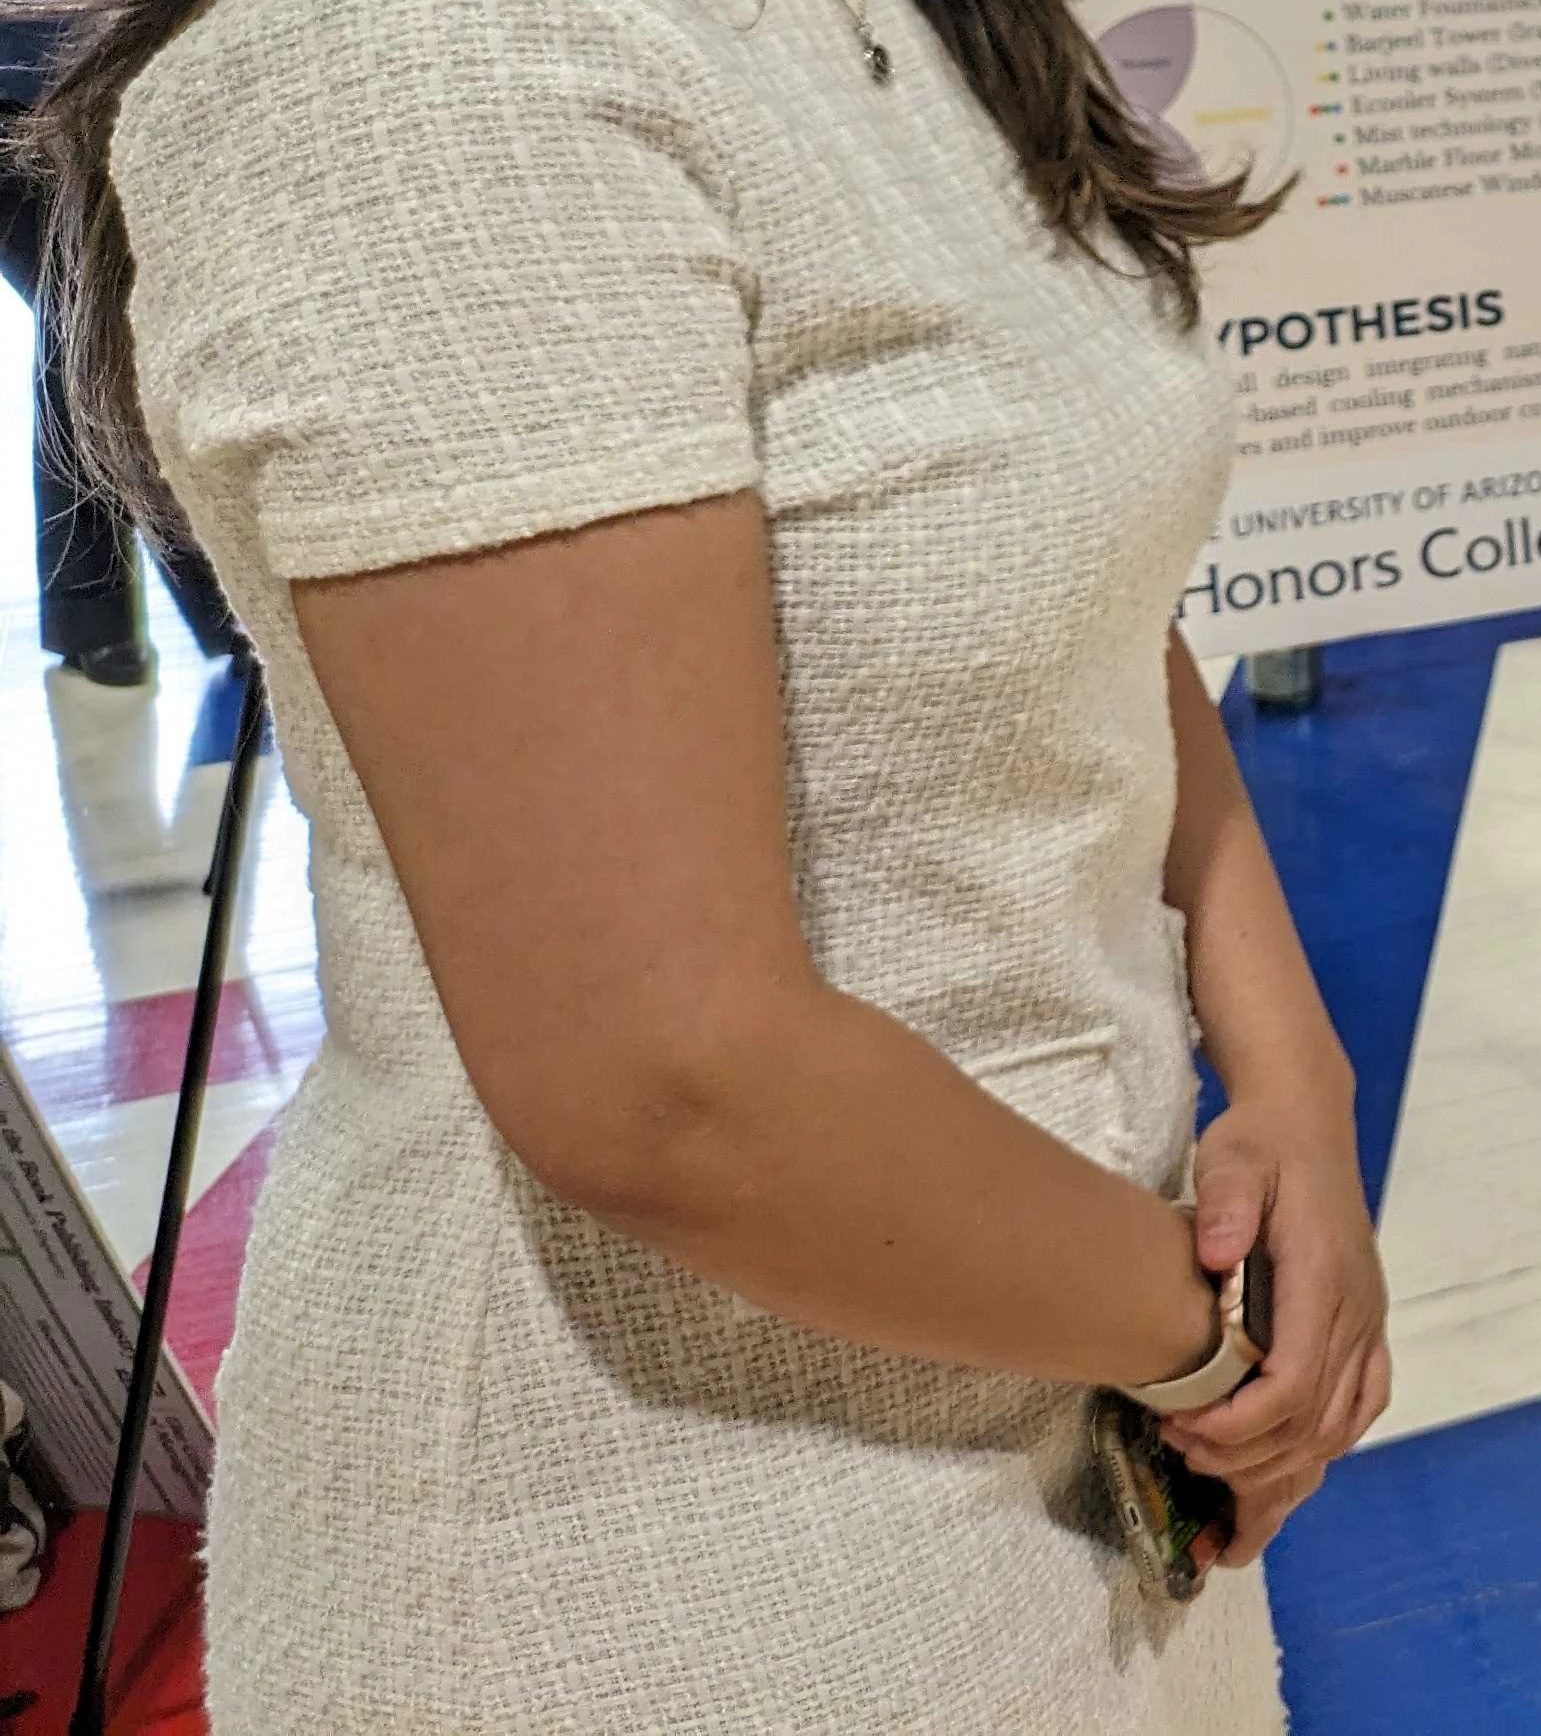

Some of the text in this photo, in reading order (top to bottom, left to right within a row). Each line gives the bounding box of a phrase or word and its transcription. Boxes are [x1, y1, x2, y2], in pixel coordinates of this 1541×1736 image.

[1230, 490, 1405, 541] UNIVERSITY
[1412, 482, 1451, 513] OF
[1176, 550, 1402, 620] Honors
